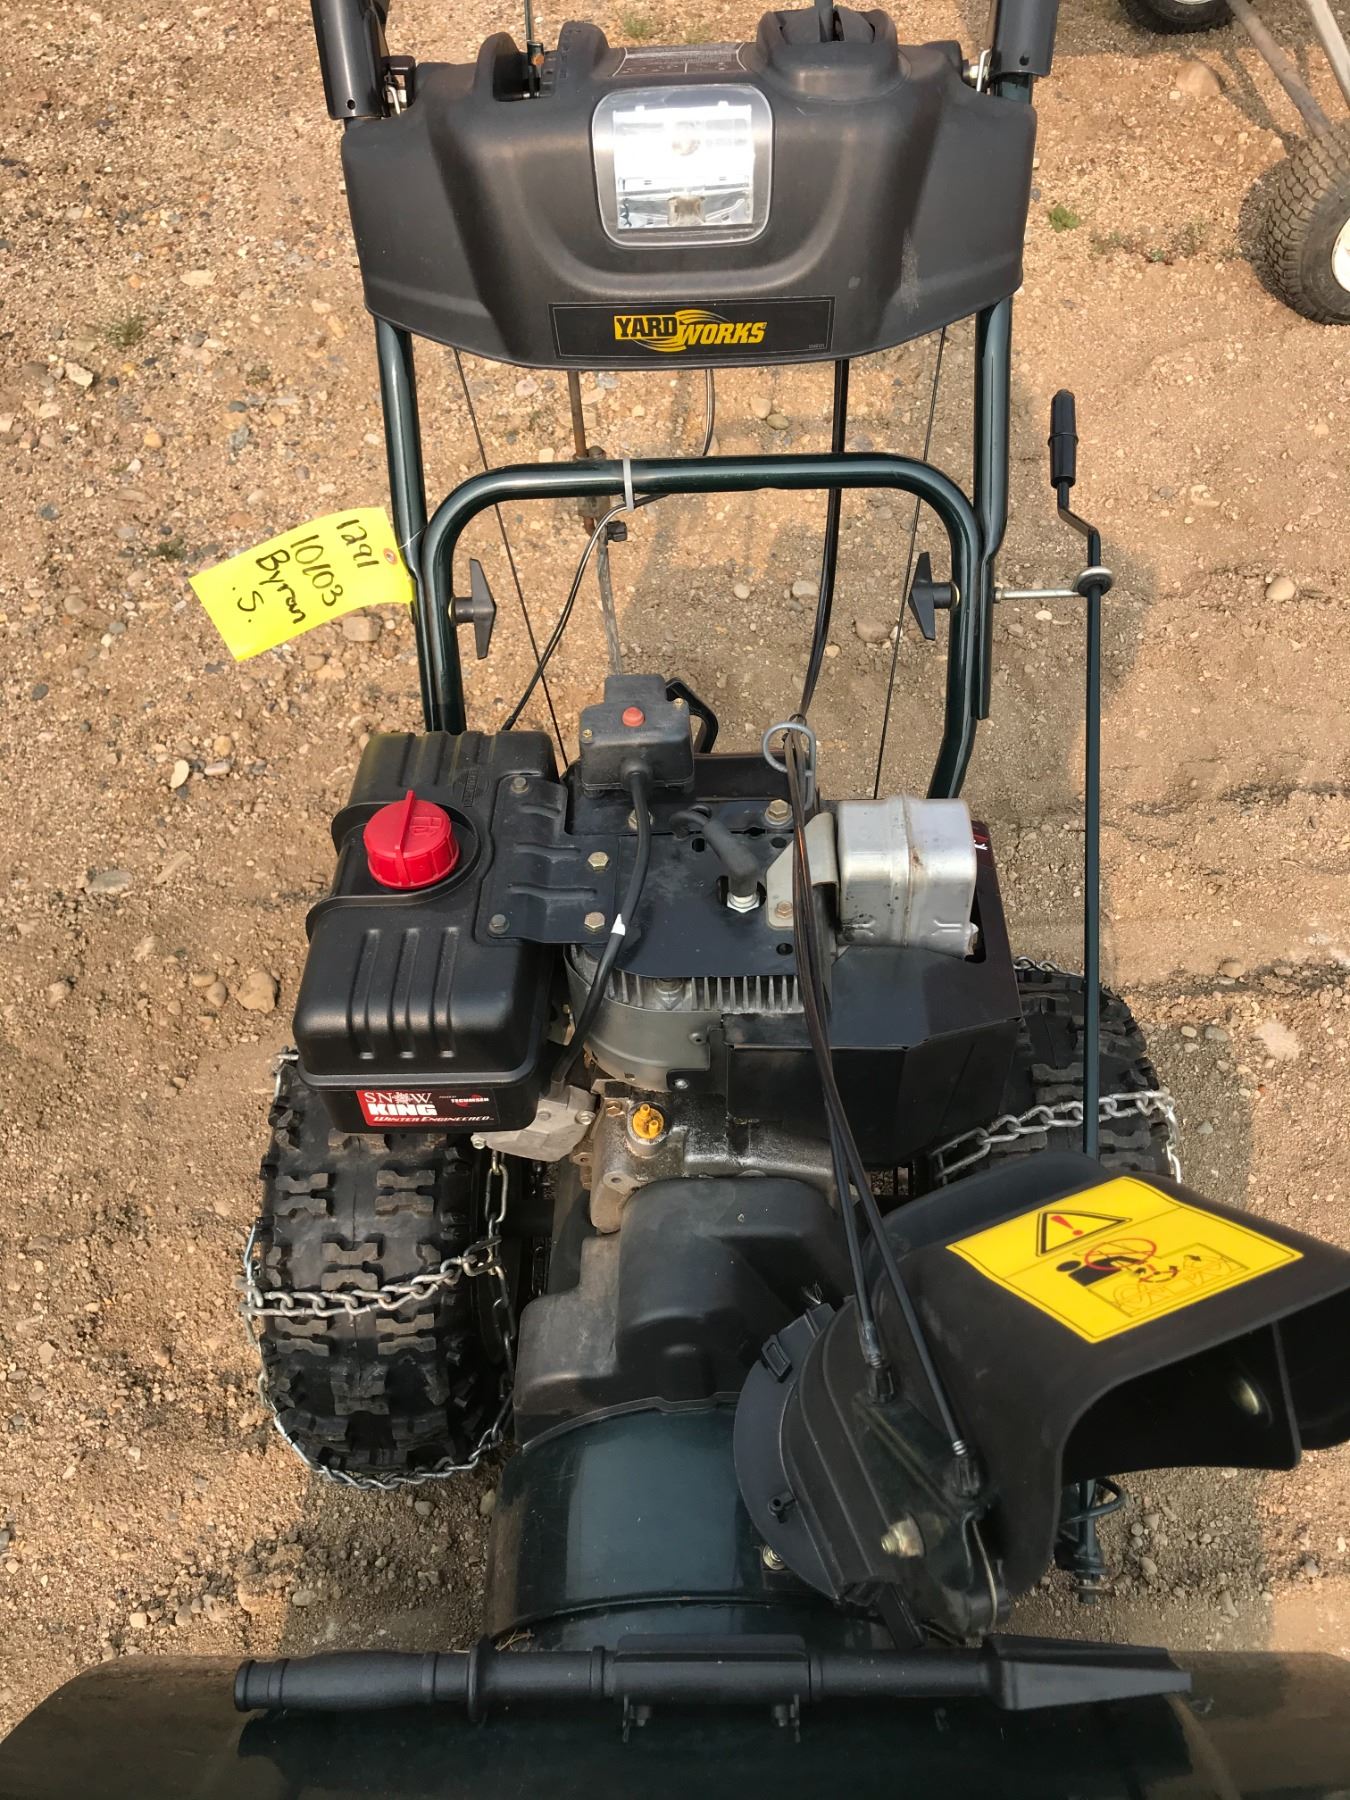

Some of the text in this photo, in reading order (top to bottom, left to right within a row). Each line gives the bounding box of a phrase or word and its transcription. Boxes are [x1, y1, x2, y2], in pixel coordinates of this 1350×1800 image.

[615, 316, 767, 345] YARD WORKS
[367, 1103, 438, 1116] KING
